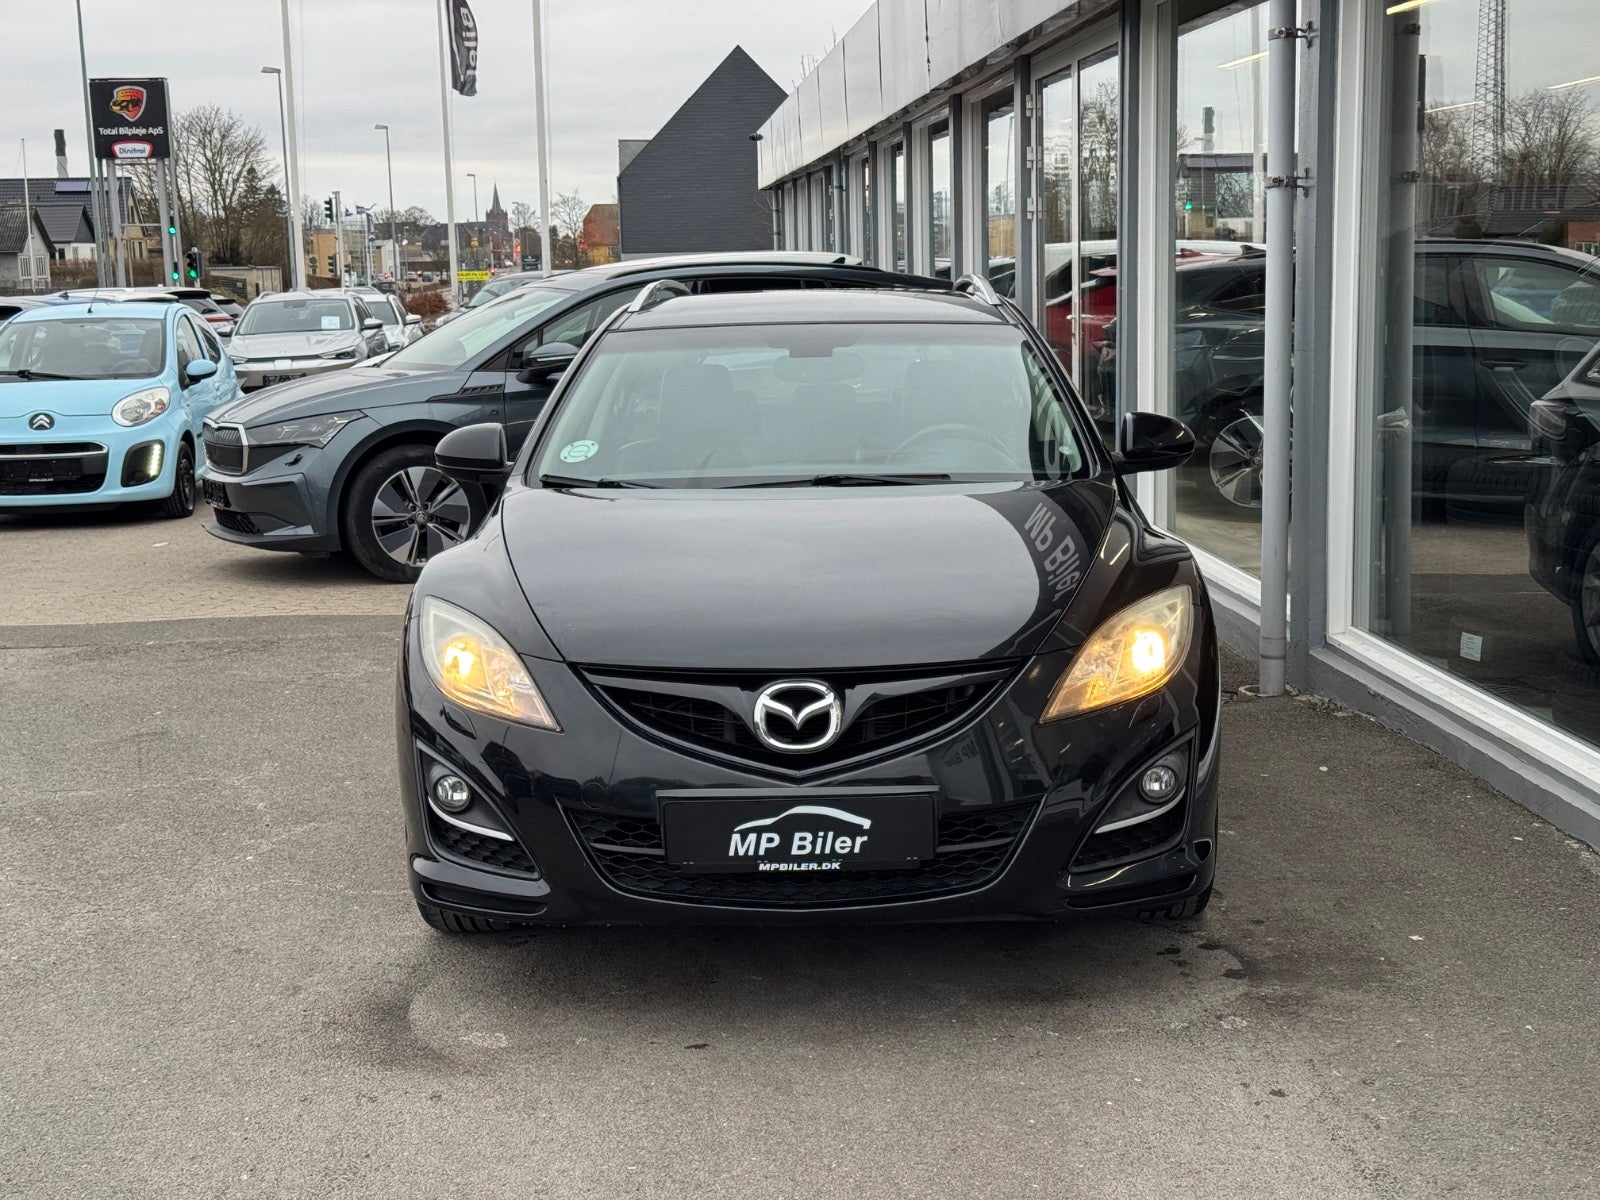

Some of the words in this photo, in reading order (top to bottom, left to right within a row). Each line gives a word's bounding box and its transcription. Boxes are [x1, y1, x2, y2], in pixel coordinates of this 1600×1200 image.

[98, 127, 118, 135] Total
[119, 126, 147, 136] Bilpleje
[148, 126, 164, 136] ApS
[728, 832, 781, 857] MP
[790, 831, 868, 856] Biler
[758, 861, 841, 871] MPBILER.DK
